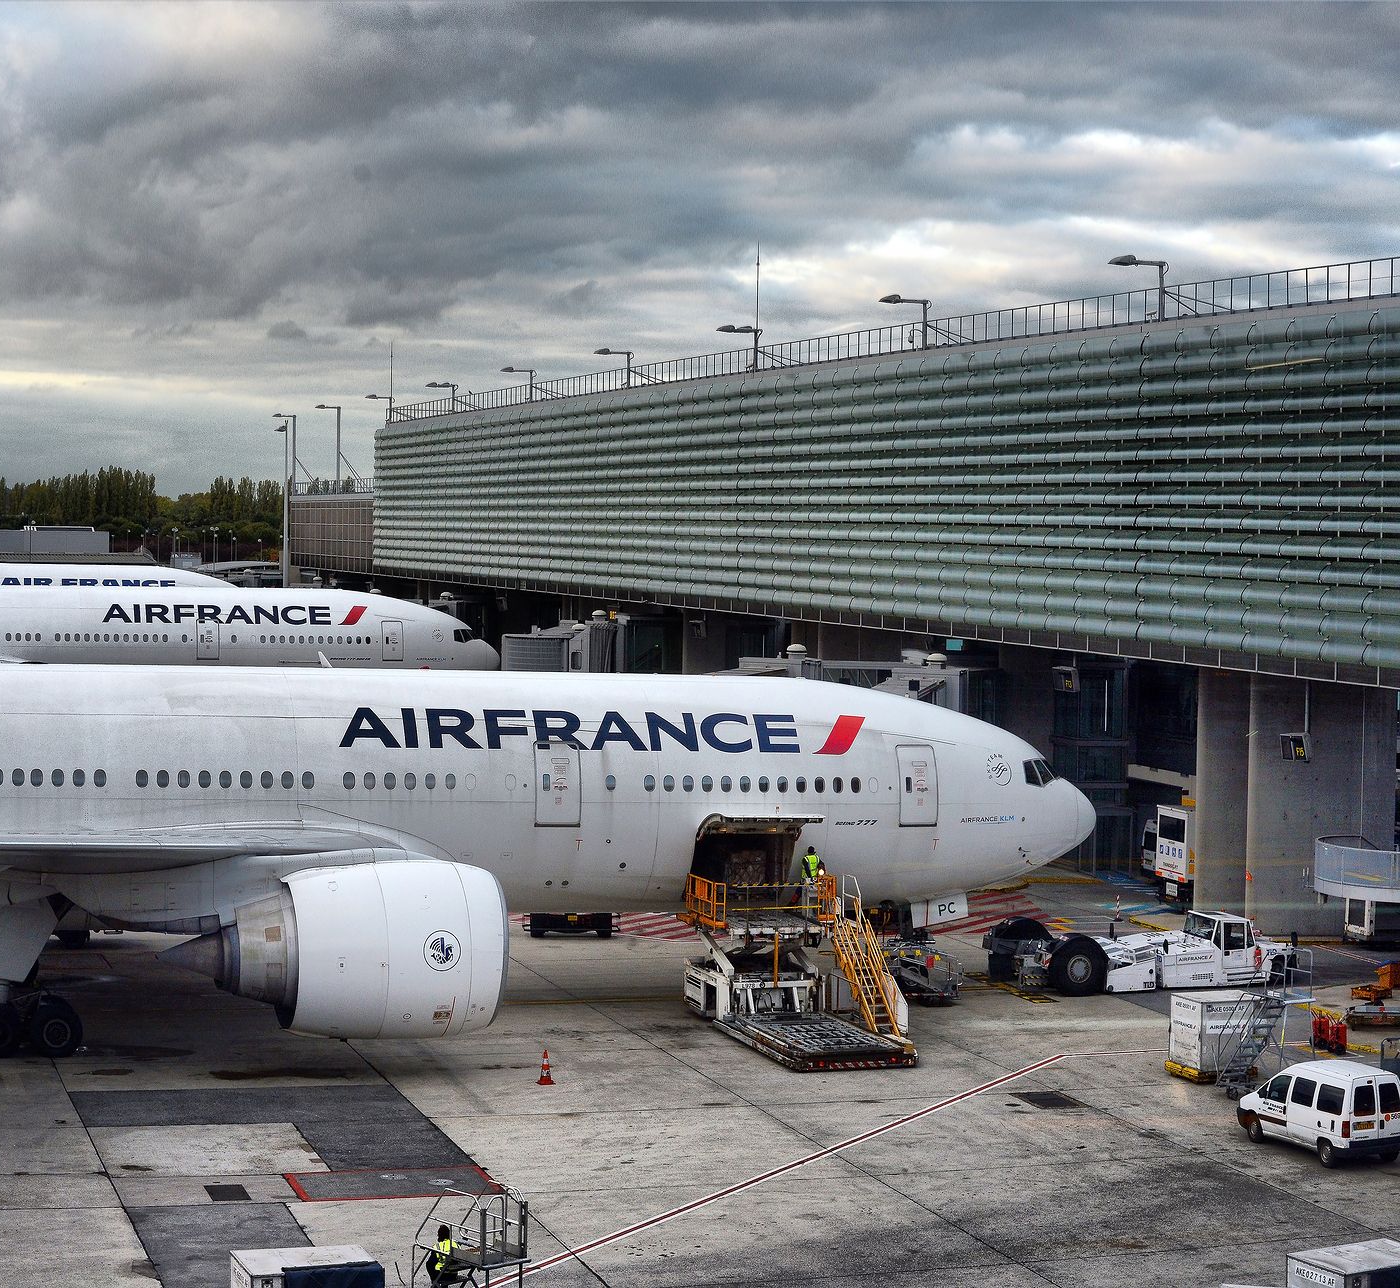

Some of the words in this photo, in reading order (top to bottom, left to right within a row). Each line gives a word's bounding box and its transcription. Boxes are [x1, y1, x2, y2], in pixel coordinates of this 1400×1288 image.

[102, 603, 332, 625] AIRFRANCE
[339, 706, 801, 754] AIRFRANCE
[960, 815, 998, 824] AIRFRANCE
[938, 901, 956, 916] PC
[1327, 1278, 1336, 1287] AF
